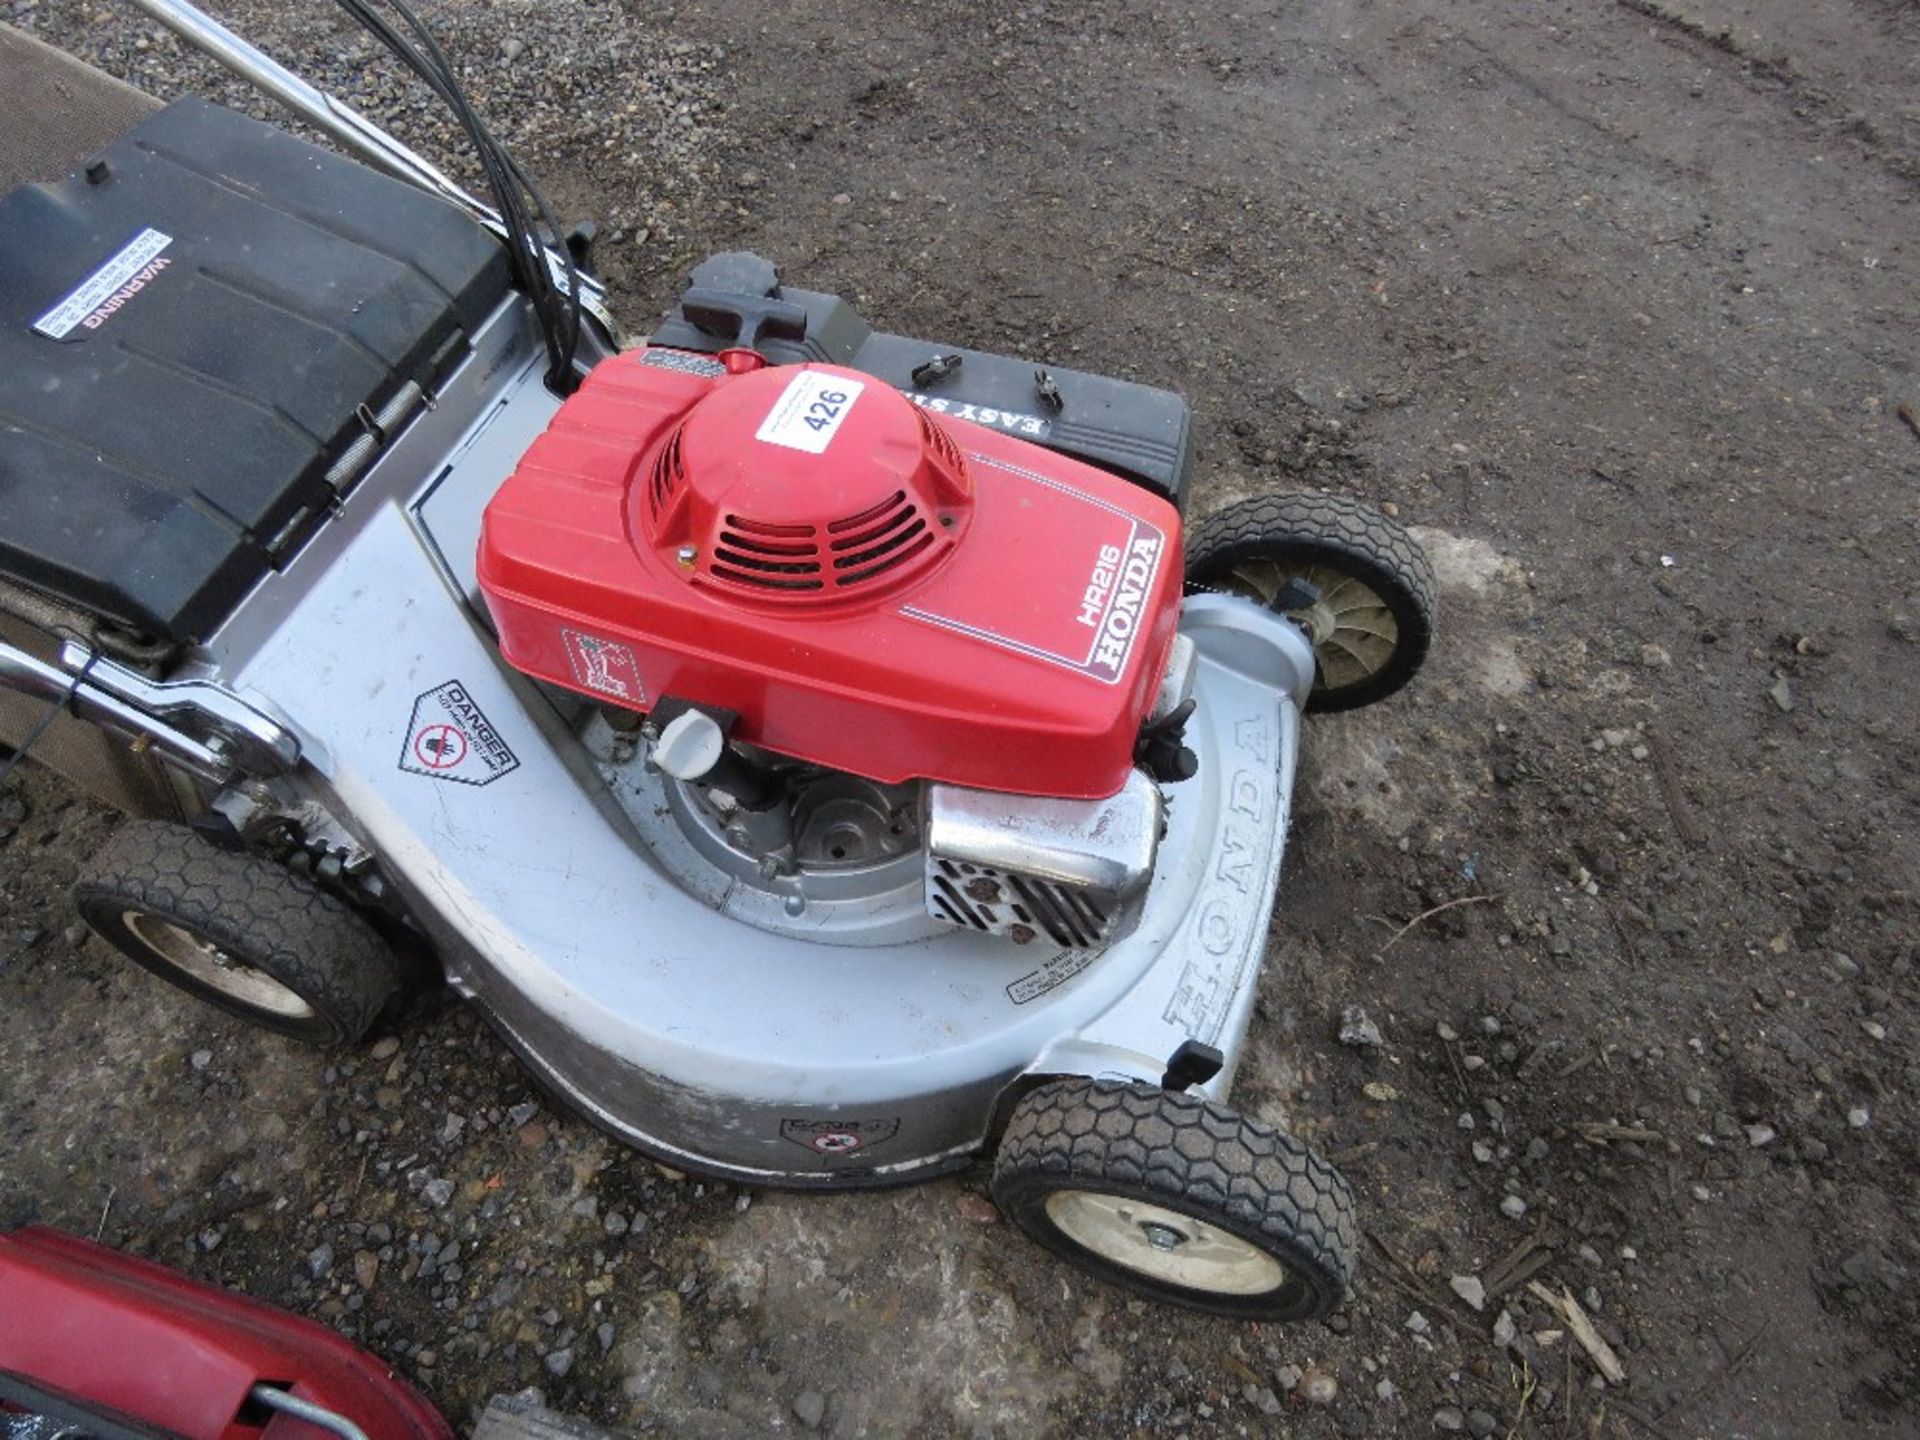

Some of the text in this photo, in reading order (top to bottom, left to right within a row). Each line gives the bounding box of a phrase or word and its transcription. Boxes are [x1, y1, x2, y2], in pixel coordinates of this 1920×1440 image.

[82, 257, 171, 329] WARNING
[804, 390, 847, 432] 426
[900, 390, 1044, 434] EASY ST
[1076, 544, 1120, 627] HR216
[1095, 538, 1157, 671] HONDA
[449, 688, 511, 766] DANGER
[1163, 714, 1268, 1039] HONDA
